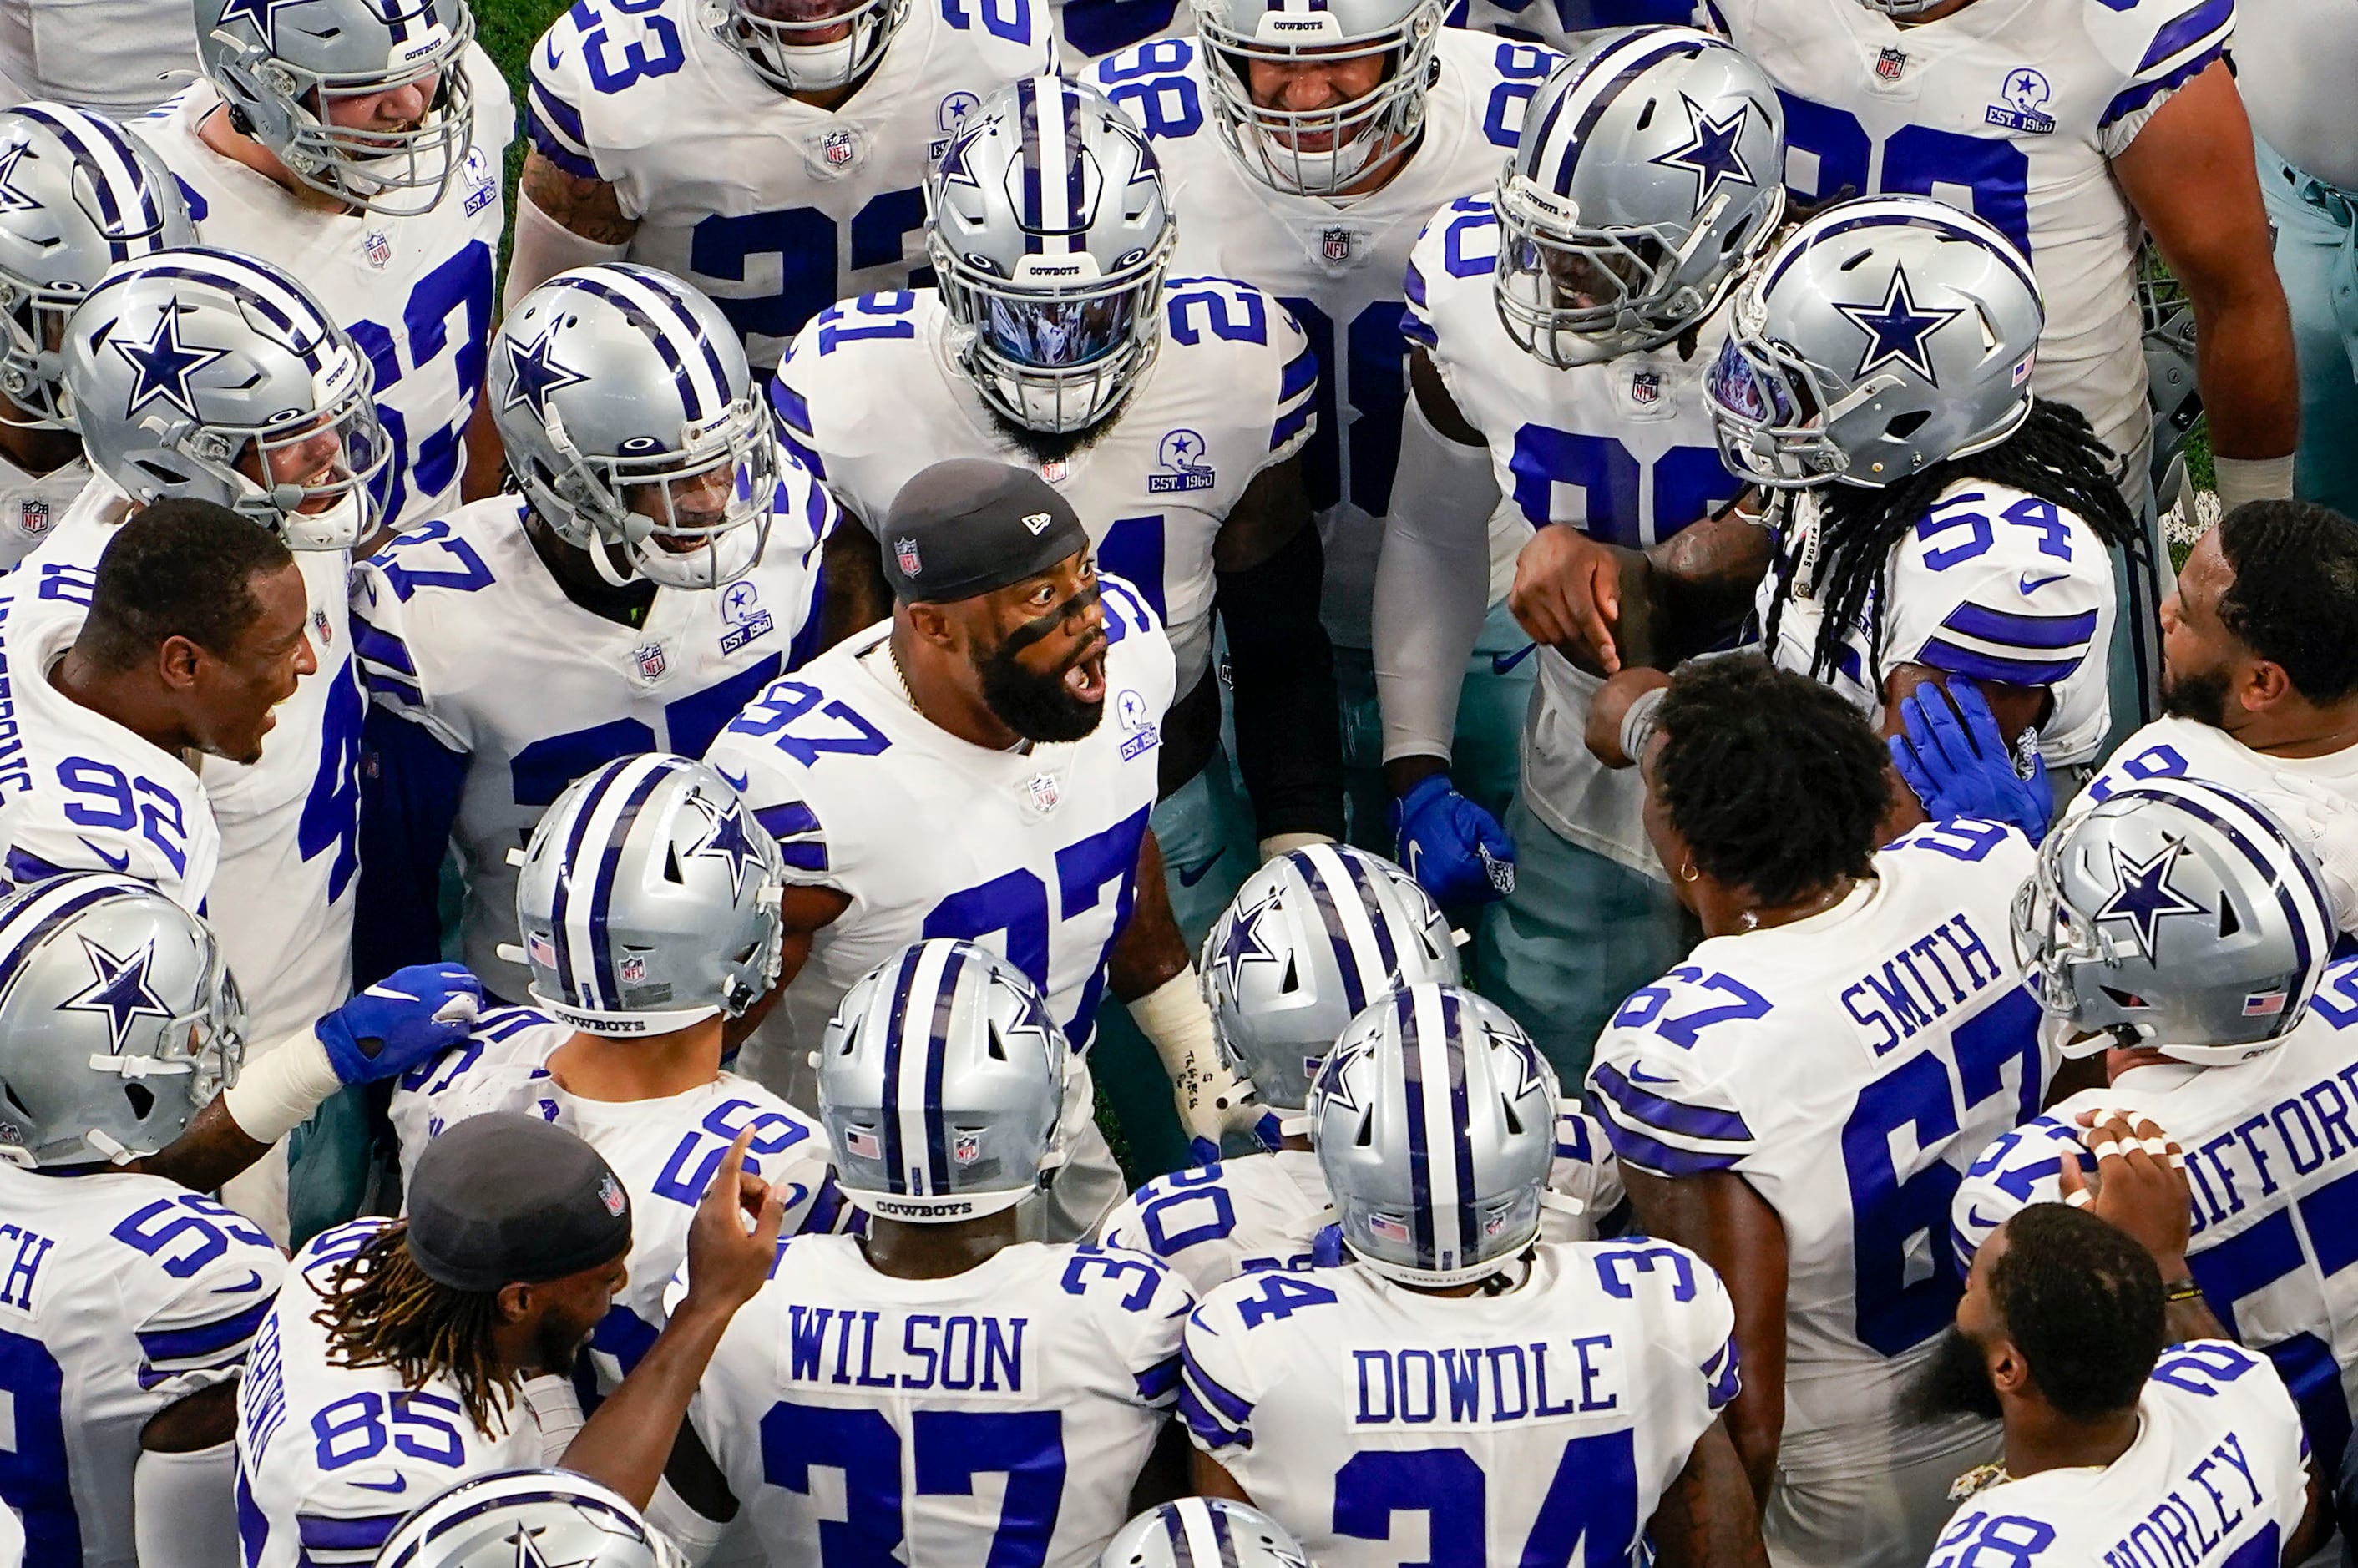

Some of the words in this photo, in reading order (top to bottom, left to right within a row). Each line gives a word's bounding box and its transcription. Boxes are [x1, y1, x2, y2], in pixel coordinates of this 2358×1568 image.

[1273, 21, 1323, 31] COWBOYS
[1879, 59, 1900, 76] NFL
[1099, 38, 1204, 142] 98
[1986, 110, 2016, 128] EST.
[827, 145, 851, 162] NFL
[367, 246, 391, 262] NFL
[1325, 242, 1347, 257] NFL
[1030, 266, 1080, 276] COWBOYS
[1636, 384, 1656, 401] NFL
[1151, 476, 1181, 491] EST.
[1186, 473, 1213, 489] 1960
[24, 513, 45, 529] NFL
[1916, 493, 2072, 572] 54
[724, 631, 748, 650] EST.
[641, 658, 661, 675] NFL
[728, 681, 893, 769] 97
[56, 756, 187, 880] 92
[625, 967, 644, 979] NFL
[1840, 913, 2002, 1058] SMITH
[1612, 966, 1774, 1050] 67
[554, 1009, 646, 1032] COWBOYS
[651, 1099, 810, 1207] 56
[958, 1146, 977, 1160] NFL
[1841, 973, 2043, 1358] 67
[876, 1201, 973, 1218] COWBOYS
[787, 1304, 1028, 1392] WILSON
[1353, 1334, 1617, 1424] DOWDLE
[2151, 1342, 2259, 1397] 2
[310, 1390, 465, 1471] 85
[760, 1399, 1067, 1568] 37
